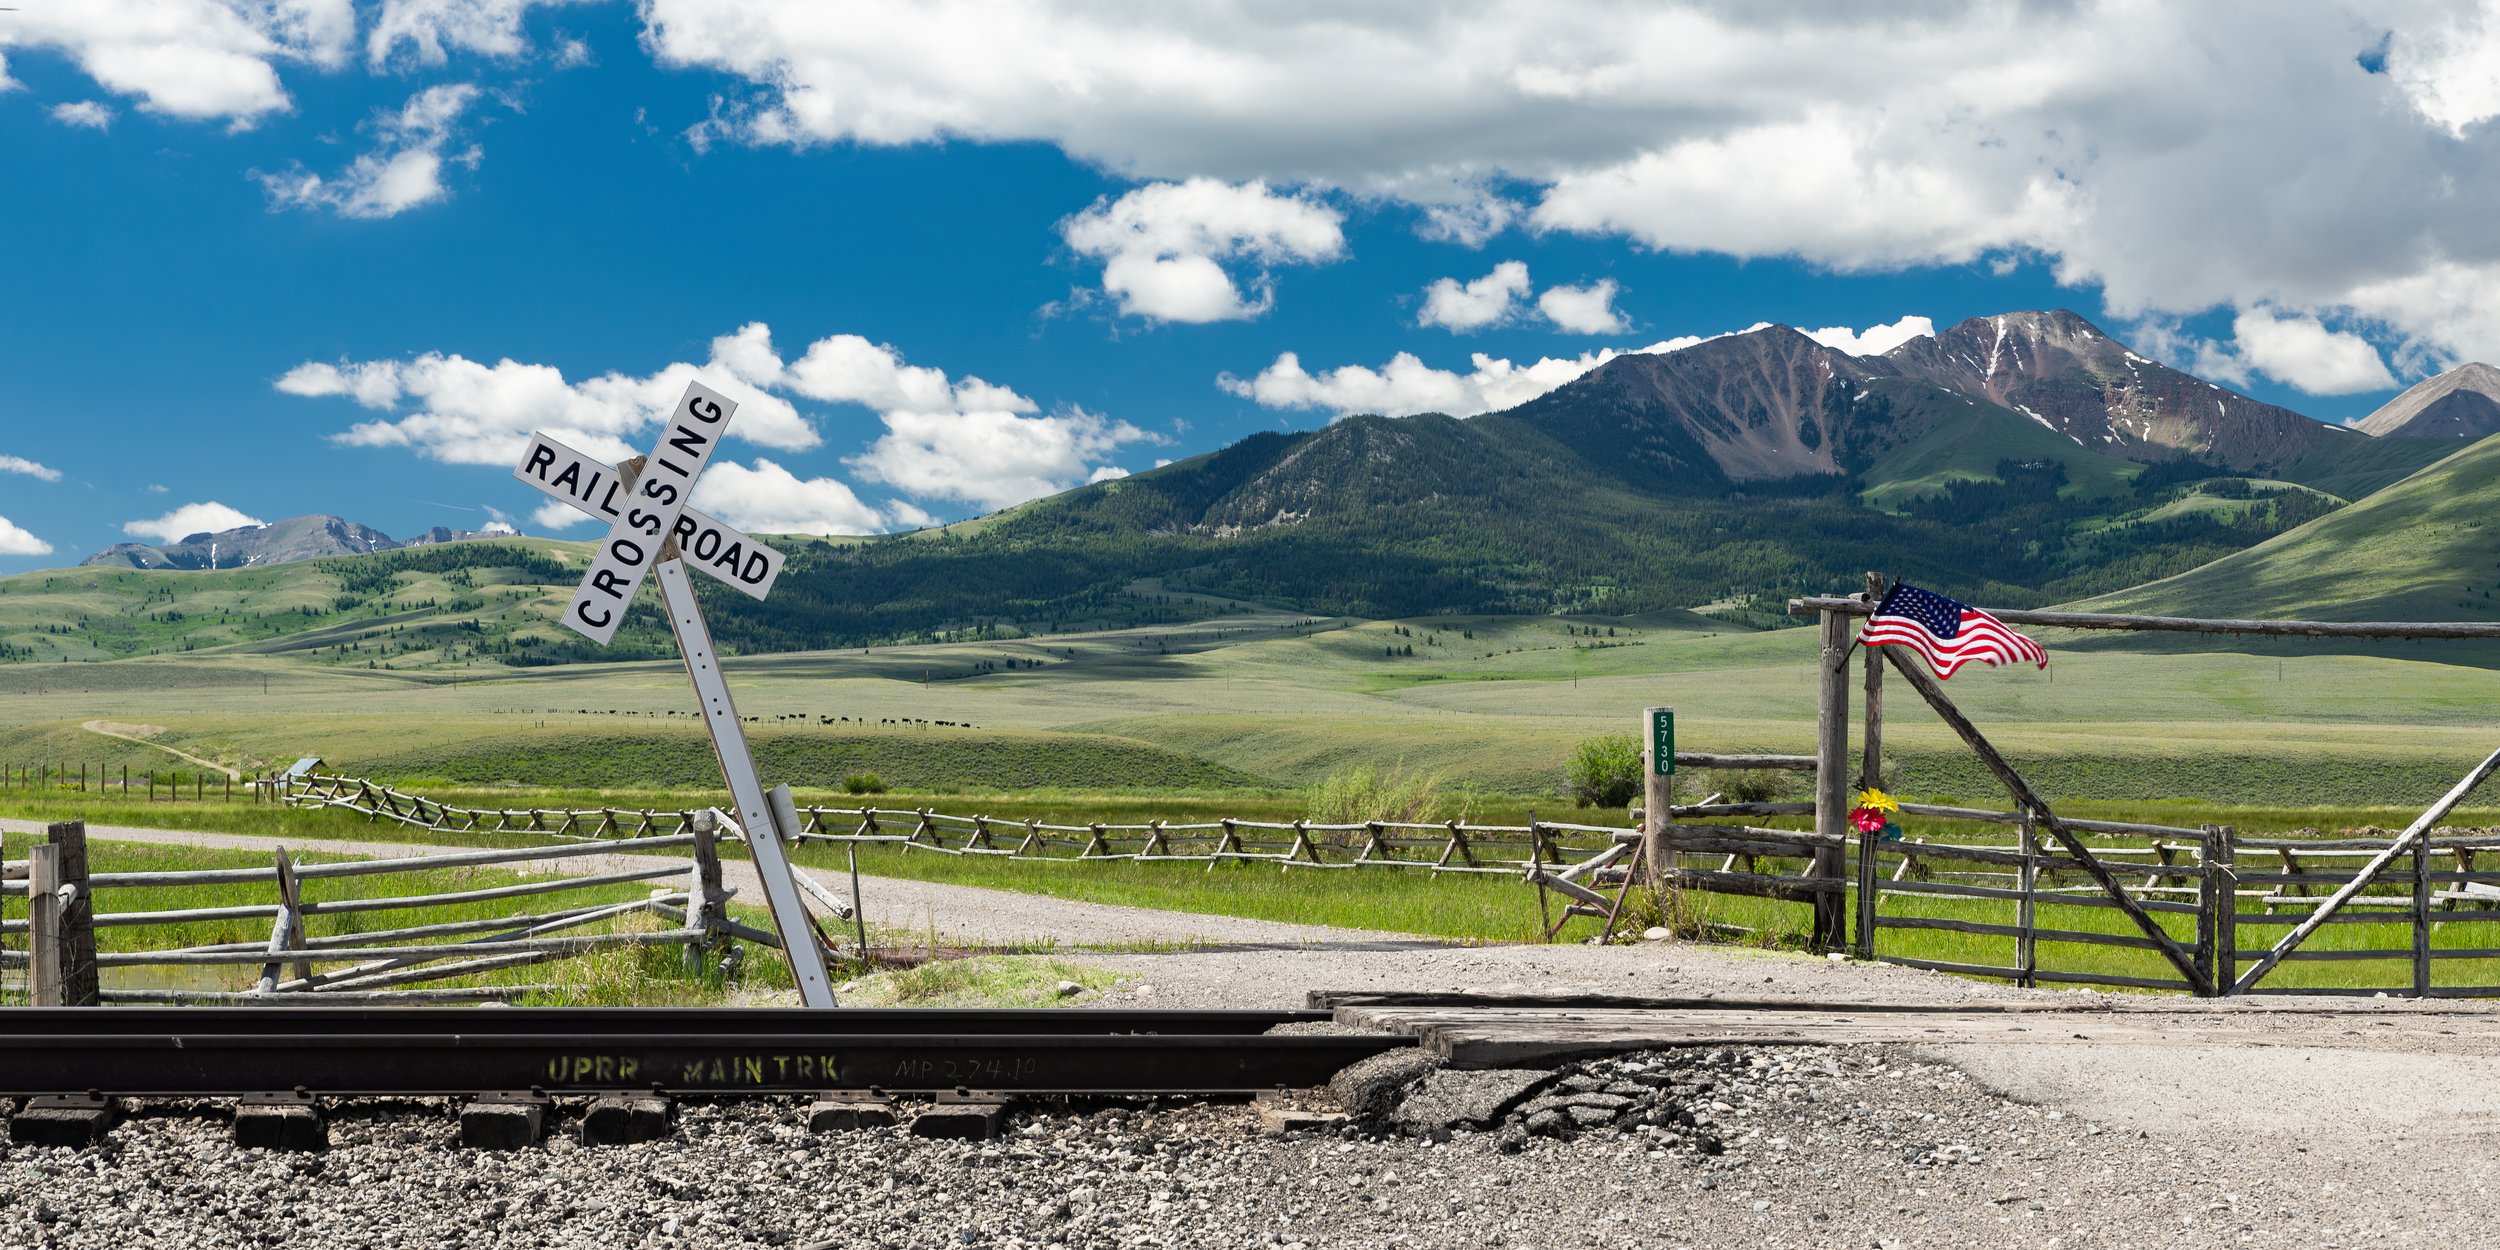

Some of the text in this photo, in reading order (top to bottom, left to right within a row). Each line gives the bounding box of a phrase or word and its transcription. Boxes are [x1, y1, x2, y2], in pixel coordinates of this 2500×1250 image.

[525, 443, 769, 585] RAIL ROAD
[577, 396, 722, 628] CROSSING
[1660, 716, 1669, 772] 5730
[548, 1055, 840, 1084] UPRR MAIN TRK
[895, 1059, 934, 1080] MP
